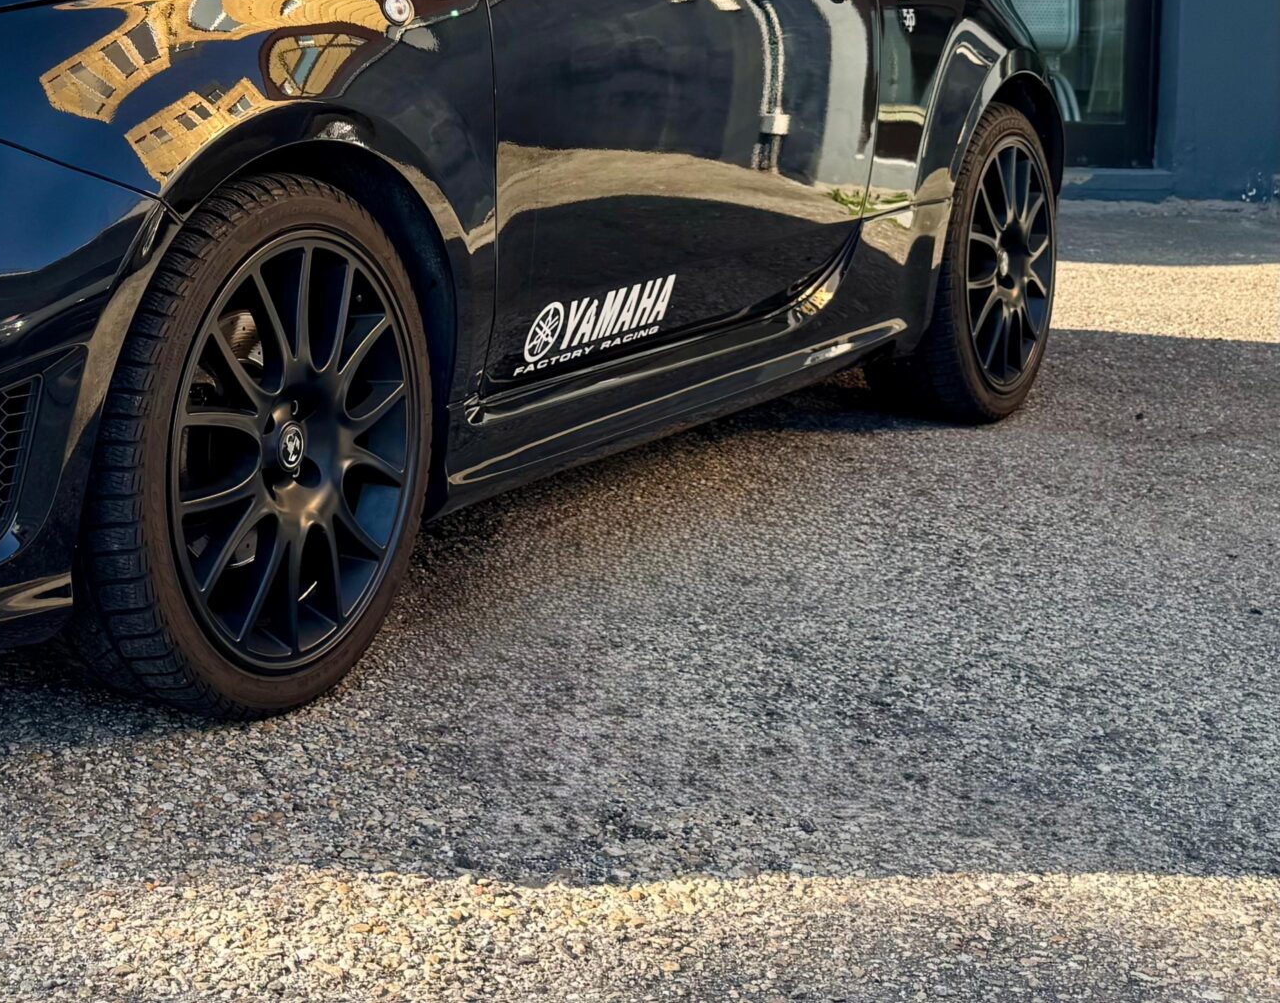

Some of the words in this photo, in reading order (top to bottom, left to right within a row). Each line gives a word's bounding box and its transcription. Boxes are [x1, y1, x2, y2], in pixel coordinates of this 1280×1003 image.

[559, 274, 677, 350] YAMAHA
[512, 345, 596, 377] FACTORY
[600, 325, 660, 350] RACING
